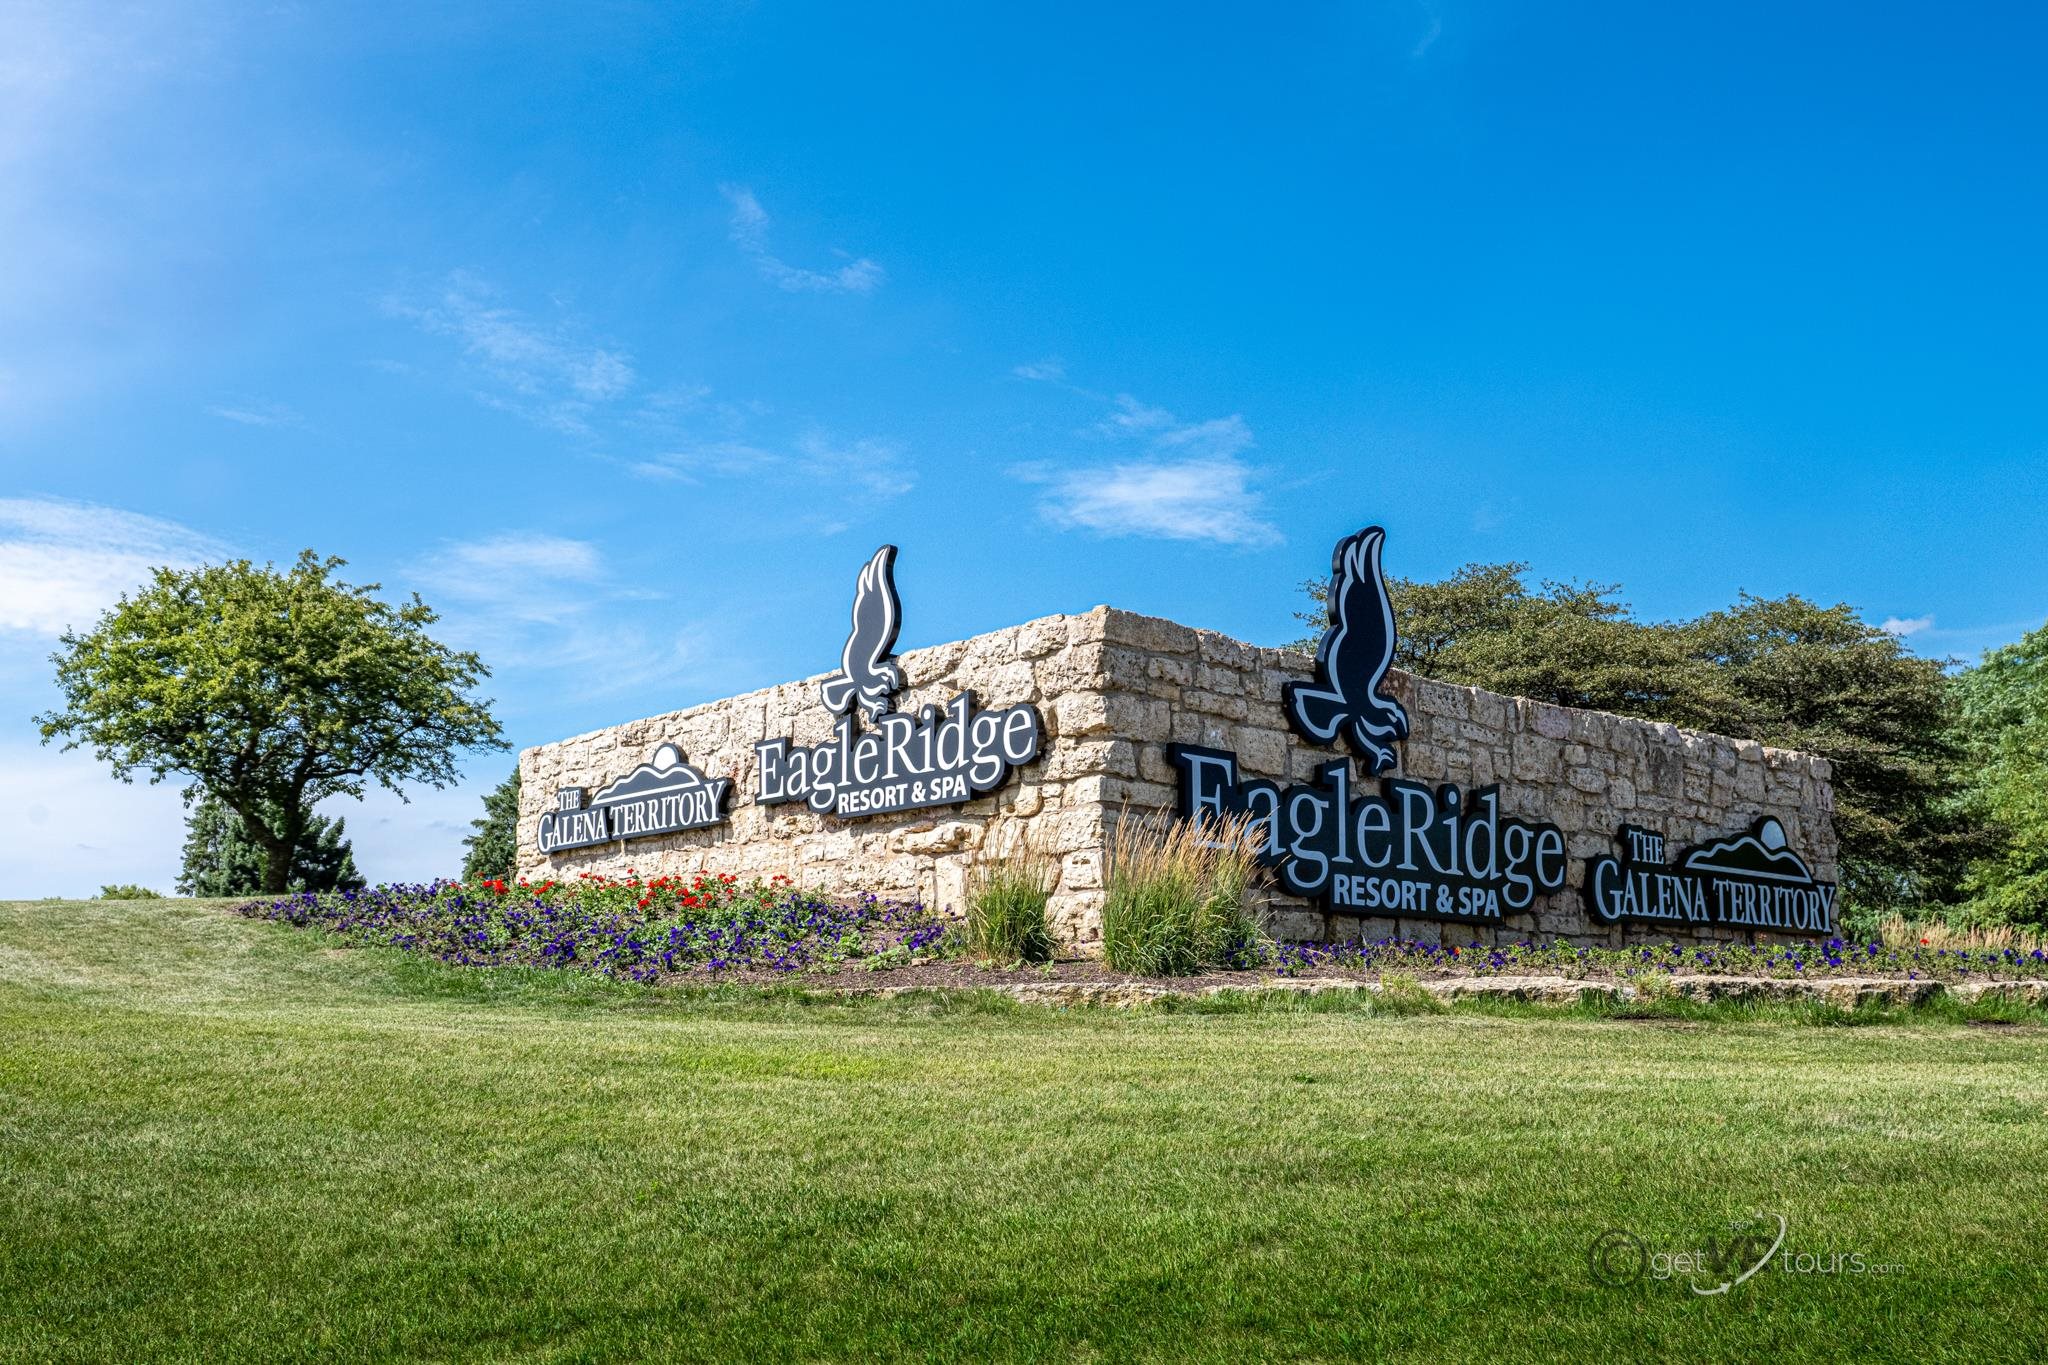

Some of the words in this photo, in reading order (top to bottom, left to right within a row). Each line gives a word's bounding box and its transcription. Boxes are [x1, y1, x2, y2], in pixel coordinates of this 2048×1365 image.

[557, 787, 579, 811] THE
[838, 786, 907, 814] RESORT
[911, 783, 926, 802] &
[930, 773, 968, 798] SPA
[537, 806, 608, 855] GALENA
[610, 780, 724, 836] TERRITORY
[1628, 828, 1665, 865] THE
[1333, 873, 1431, 911] RESORT
[1435, 884, 1453, 914] &
[1458, 887, 1501, 918] SPA
[1594, 858, 1708, 922] GALENA
[1712, 879, 1836, 934] TERRITORY
